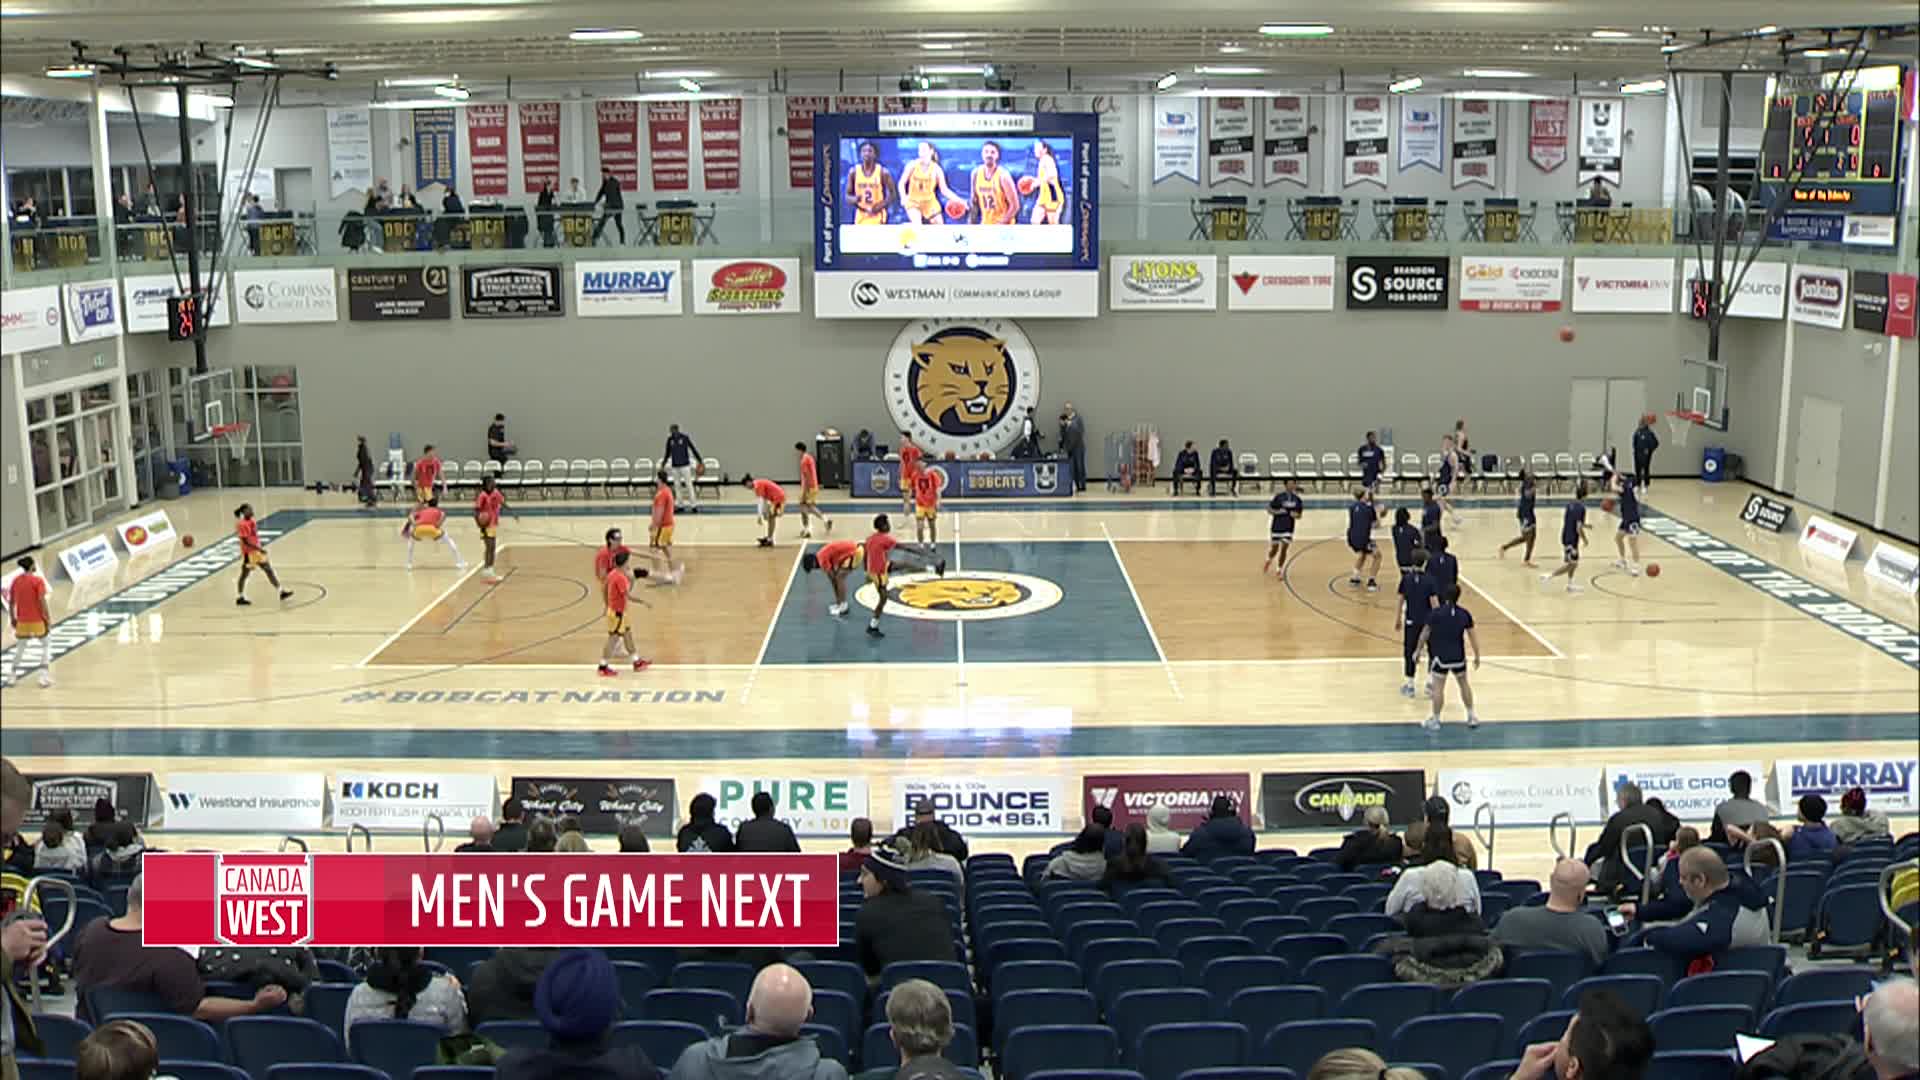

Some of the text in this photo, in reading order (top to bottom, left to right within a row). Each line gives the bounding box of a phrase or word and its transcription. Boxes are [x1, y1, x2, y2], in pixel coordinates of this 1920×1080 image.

[1131, 261, 1199, 279] LYONS
[1393, 266, 1436, 275] BRANDON
[1465, 265, 1504, 279] Gold
[351, 275, 392, 285] CENTURY
[429, 269, 447, 287] 21
[582, 270, 674, 292] MURRAY
[1262, 276, 1332, 286] CANADIAN TIRE
[1383, 277, 1444, 291] SOURCE
[1595, 279, 1649, 289] VICTORIA
[267, 280, 331, 298] COMPASS
[885, 288, 1062, 300] WESTMAN COMMUNICATIONS GROUP
[1388, 293, 1438, 301] FOR SPORTS
[969, 475, 1025, 489] BOBCATS
[1791, 761, 1916, 788] MURRAY
[367, 782, 439, 799] KOCH
[719, 780, 848, 811] PURE
[199, 797, 321, 809] Westland Insurance
[905, 791, 1049, 810] BOUNCE
[1123, 790, 1209, 807] VICTORIA
[520, 799, 585, 813] Wheat City
[599, 799, 665, 813] Wheat City
[1006, 812, 1049, 826] 96.1
